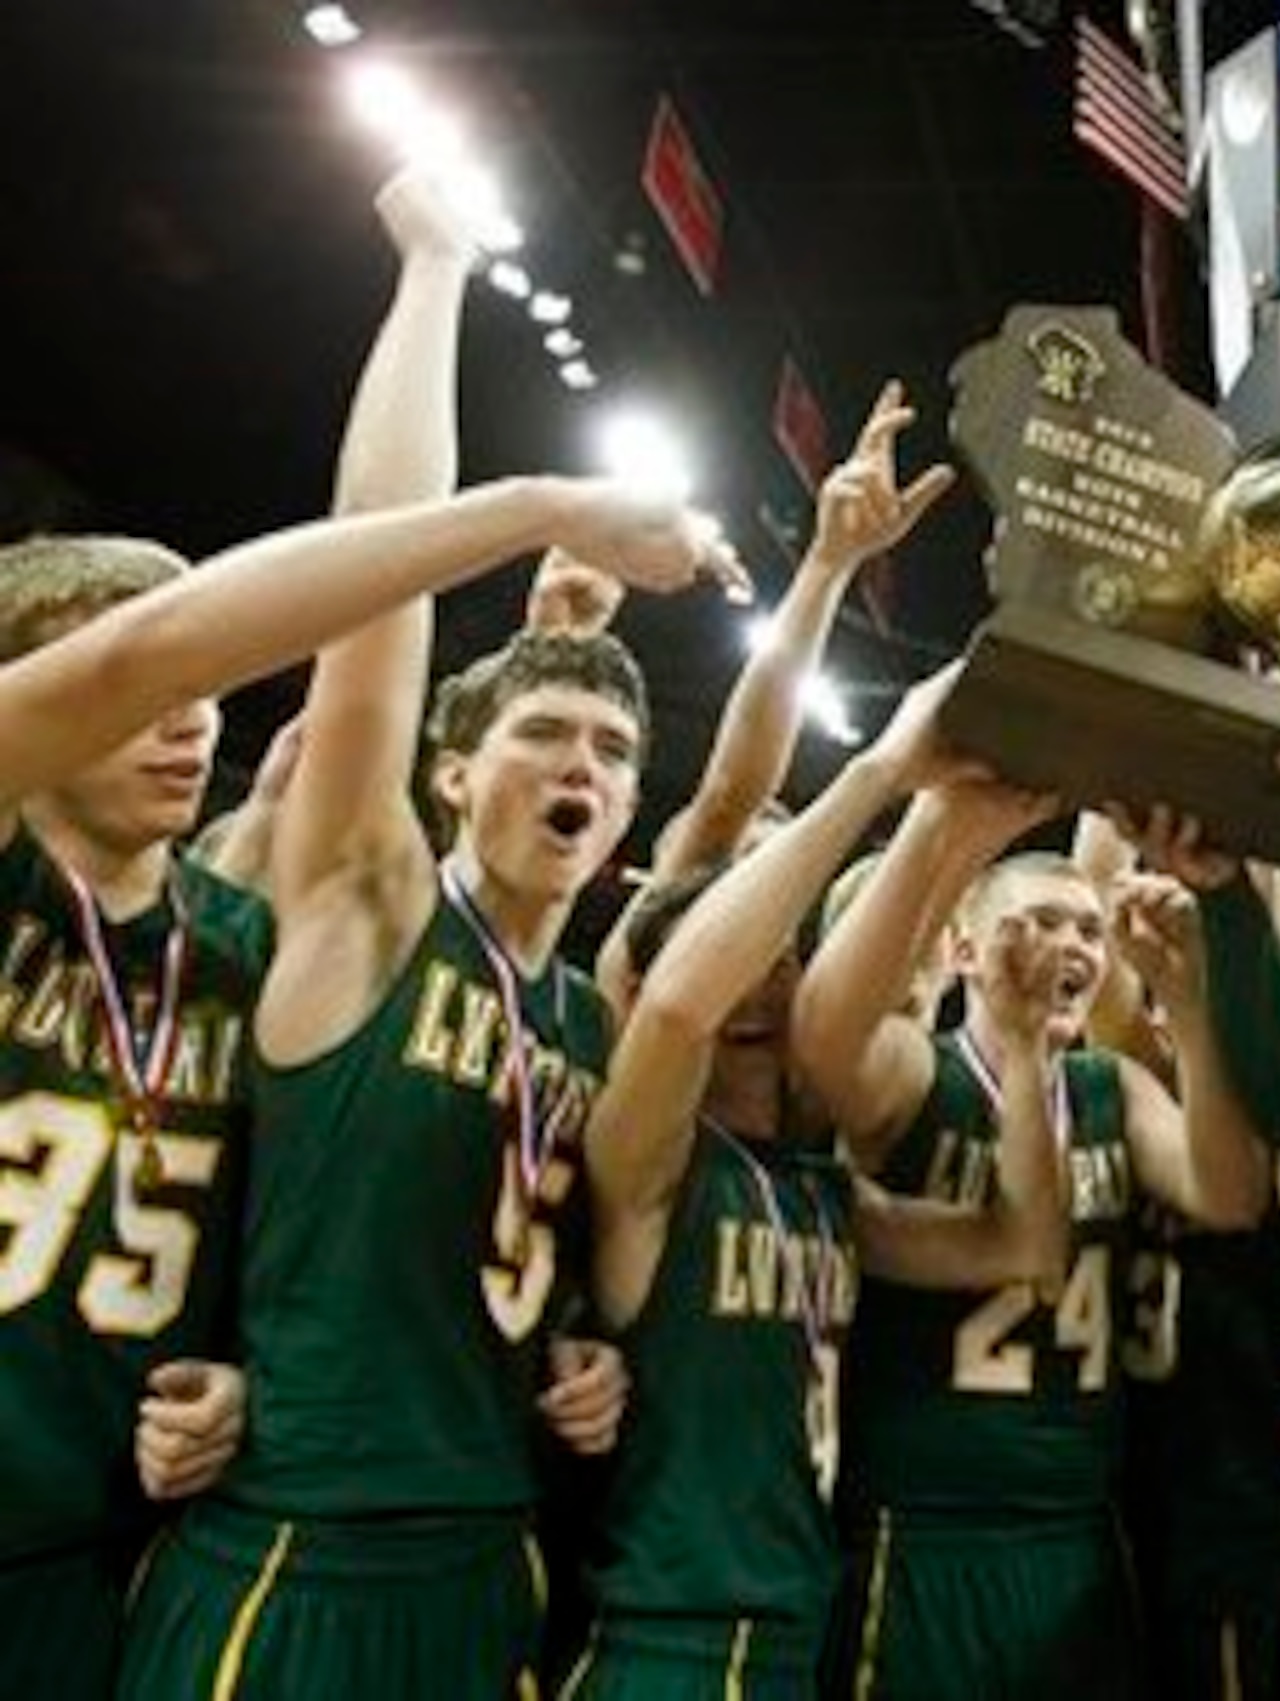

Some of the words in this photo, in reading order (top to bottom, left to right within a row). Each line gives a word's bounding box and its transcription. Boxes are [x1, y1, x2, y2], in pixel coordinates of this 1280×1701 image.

[1024, 416, 1093, 465] STATE
[1015, 475, 1182, 549] BASKETBALL
[1022, 505, 1147, 562] DIVISION
[0, 1092, 222, 1336] 35
[953, 1246, 1111, 1392] 24
